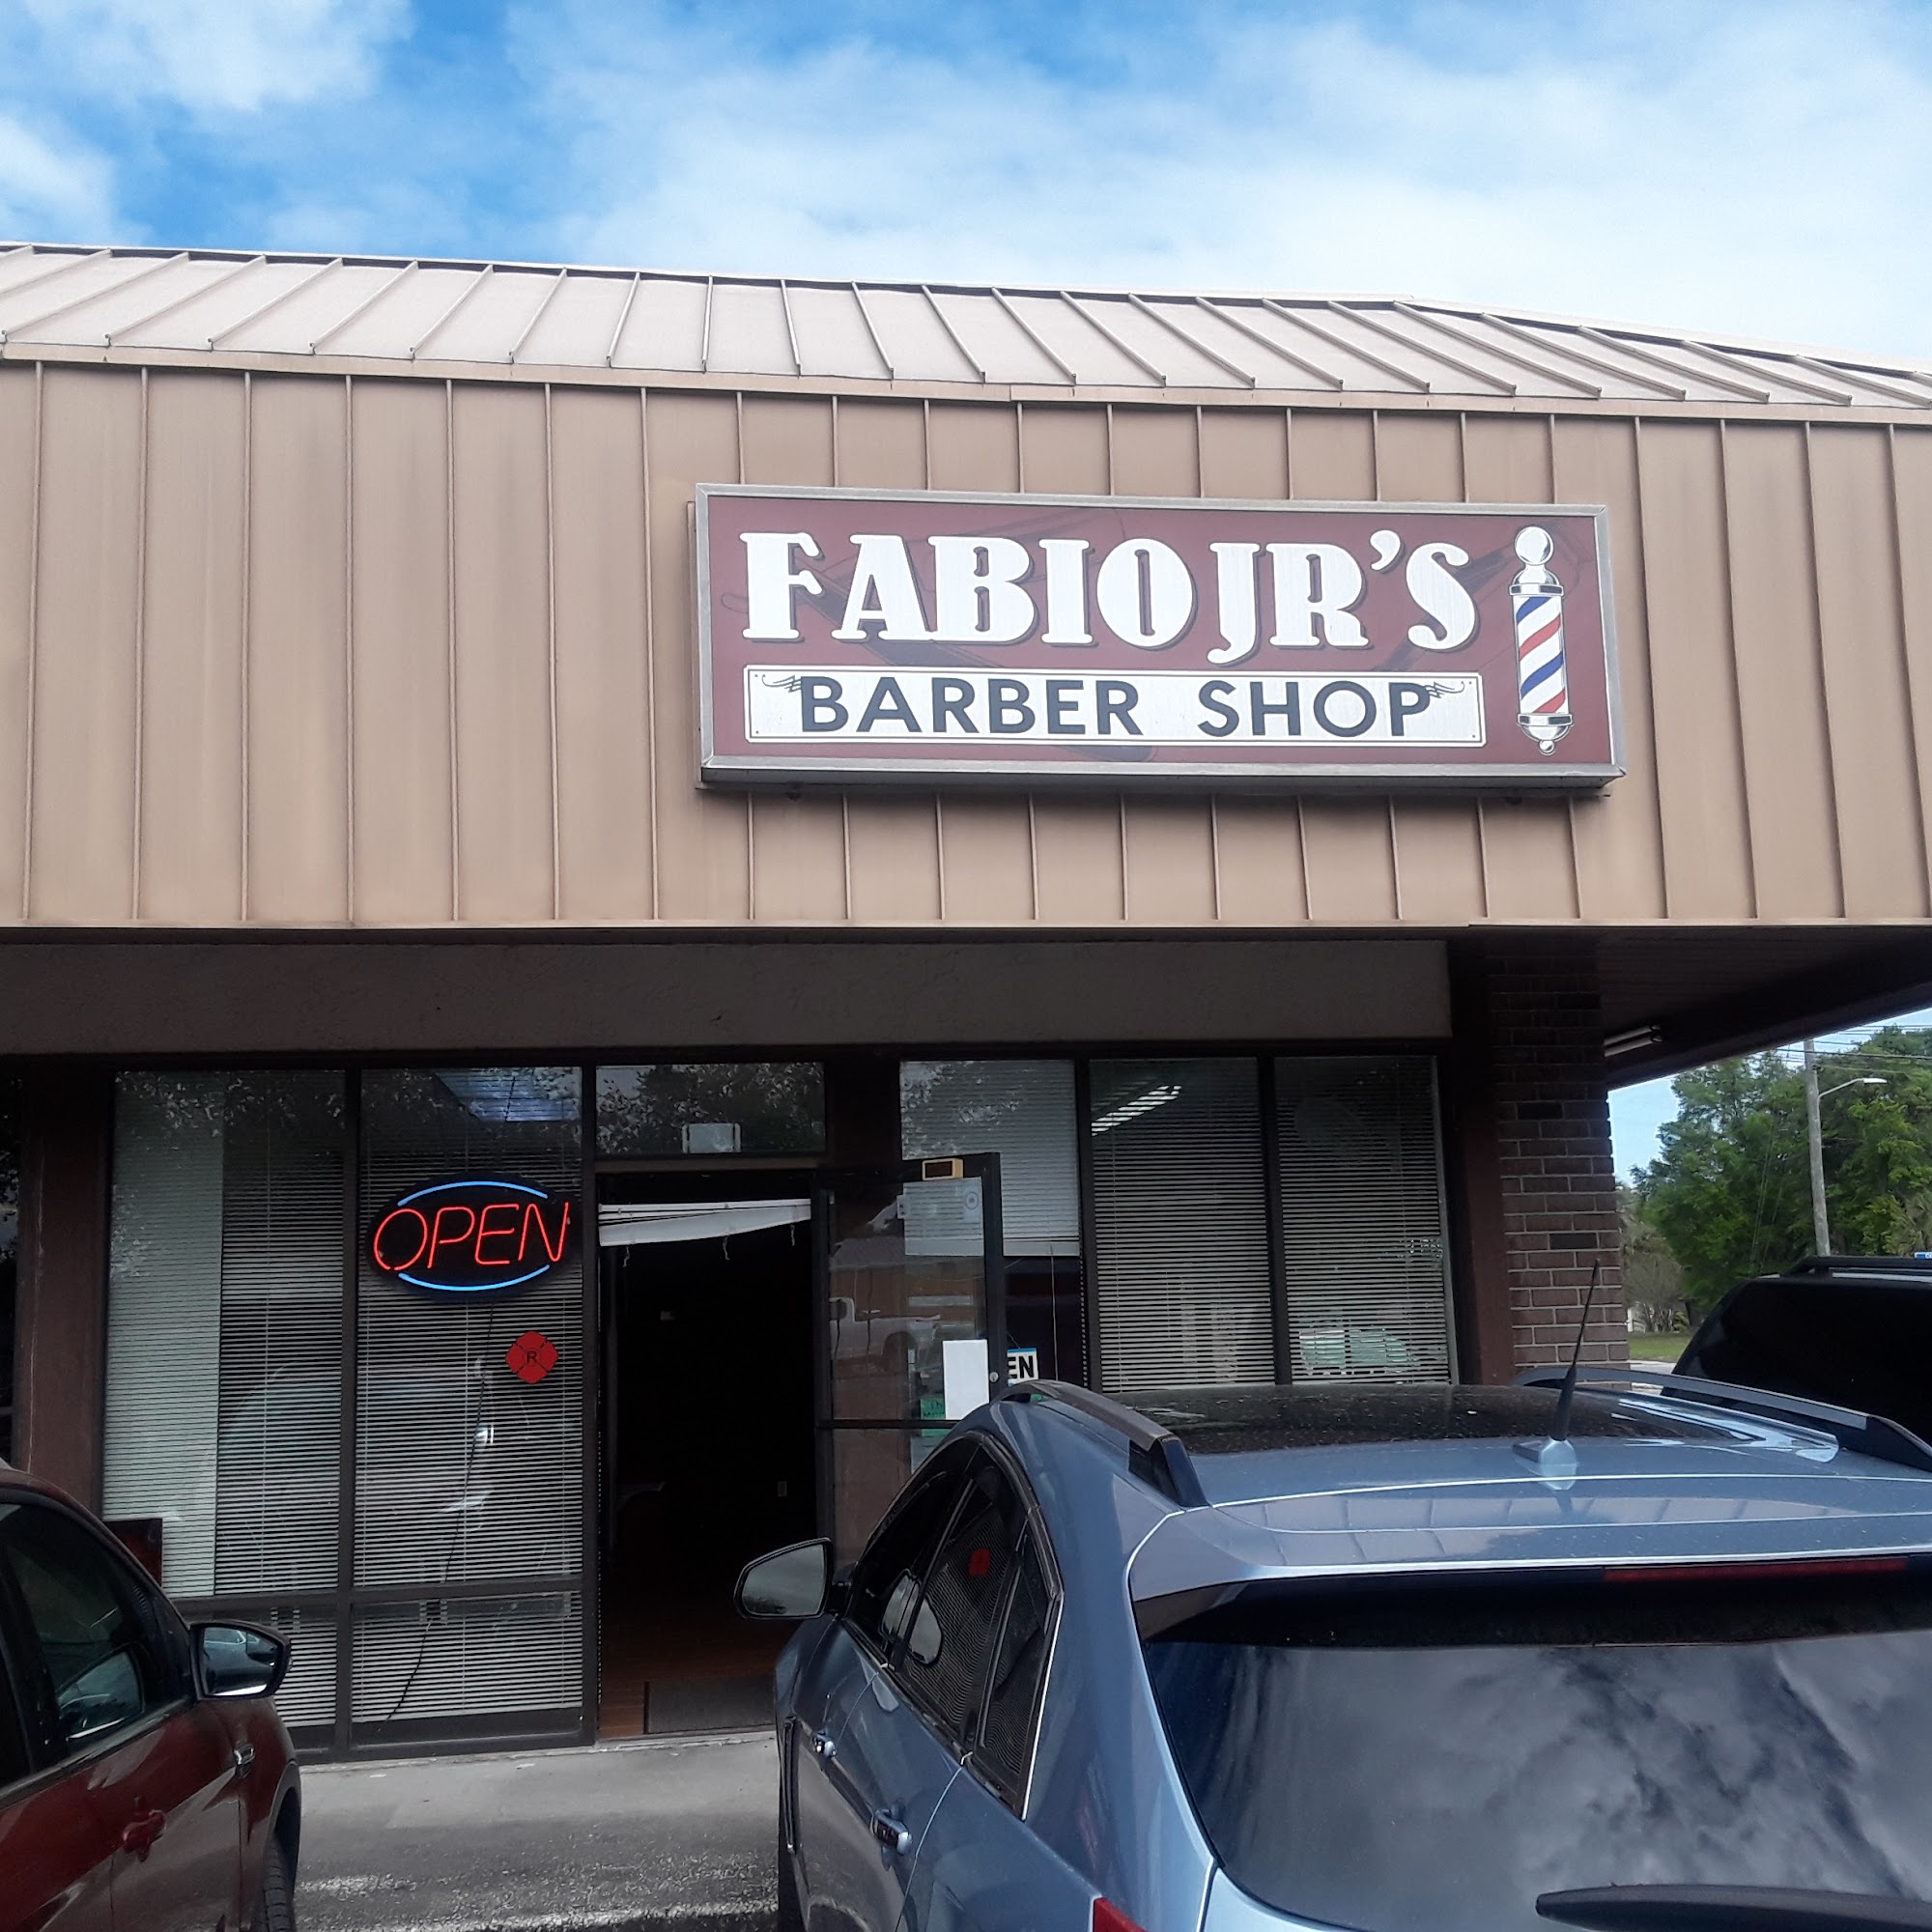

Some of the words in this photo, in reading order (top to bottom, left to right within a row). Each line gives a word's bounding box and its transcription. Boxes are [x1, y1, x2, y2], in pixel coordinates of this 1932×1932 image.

[801, 675, 1144, 736] BARBER
[1197, 679, 1431, 738] SHOP
[373, 1202, 569, 1271] OPEN
